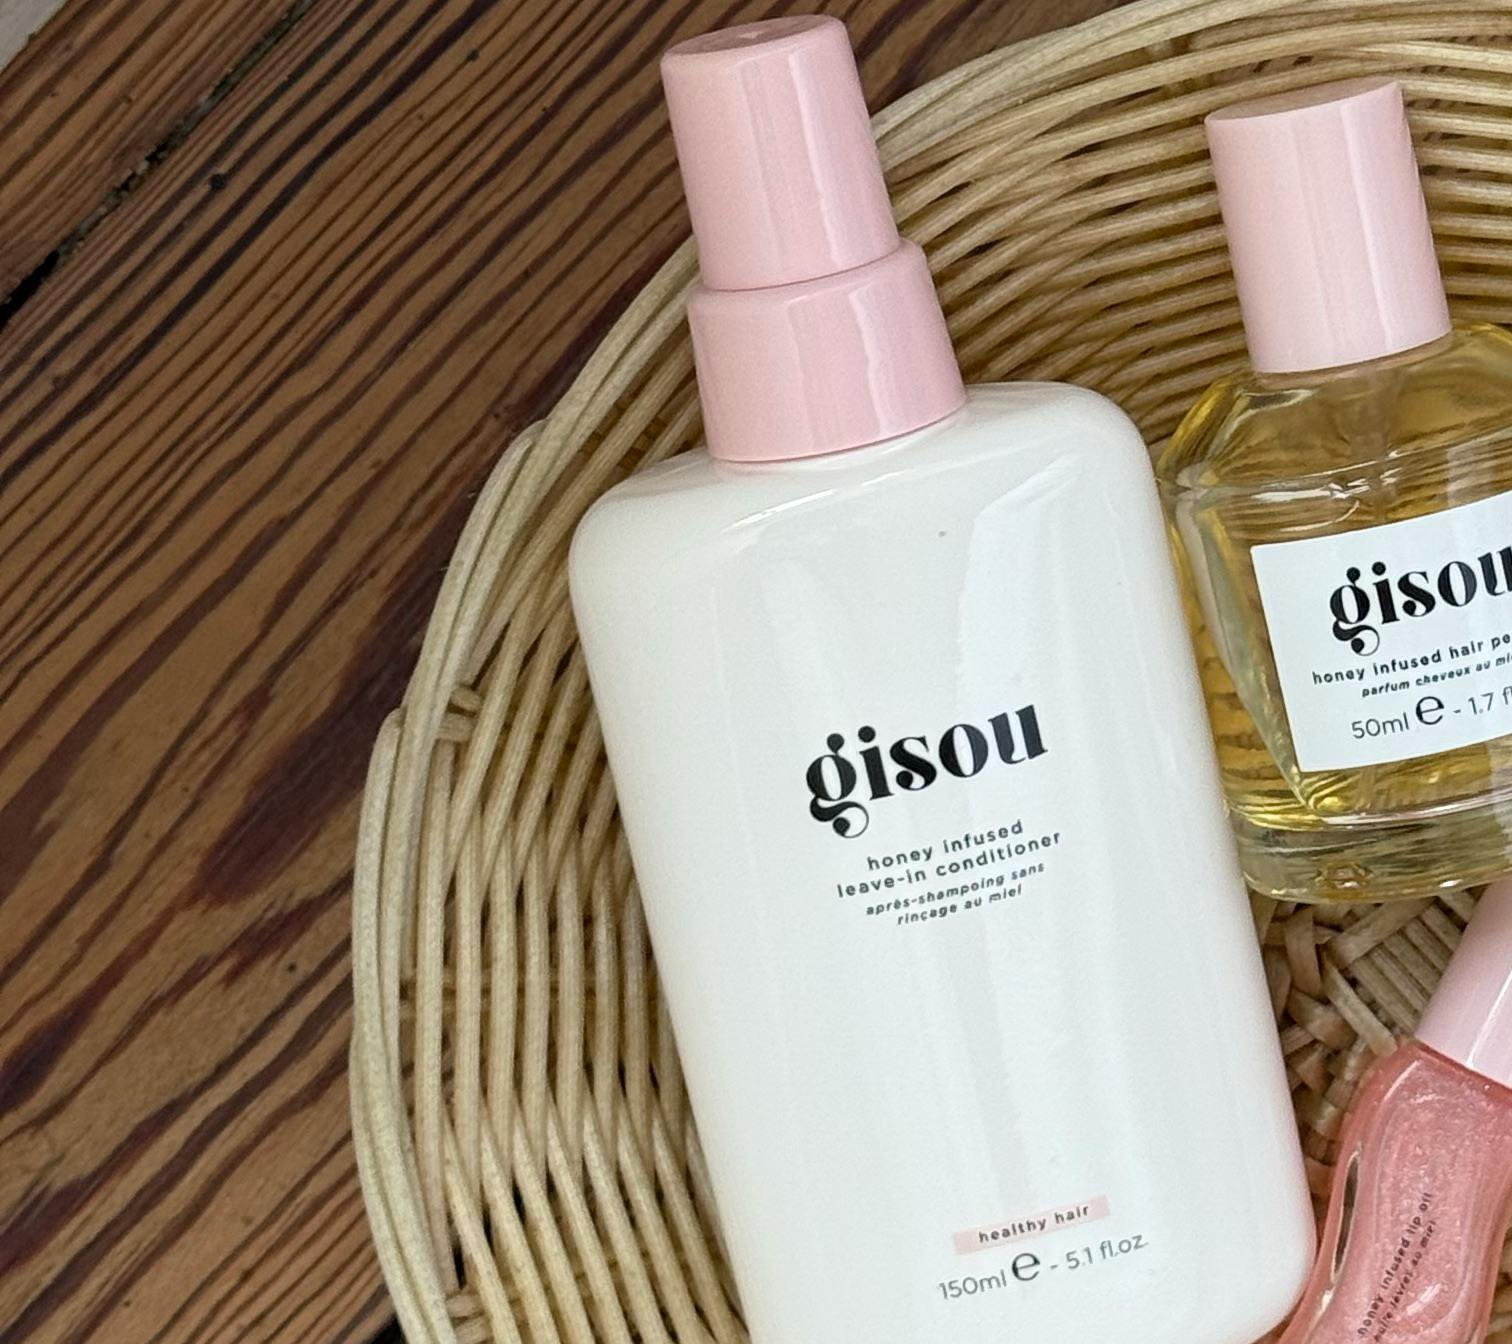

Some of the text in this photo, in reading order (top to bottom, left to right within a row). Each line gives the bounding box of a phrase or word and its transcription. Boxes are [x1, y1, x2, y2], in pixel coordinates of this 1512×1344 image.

[1312, 666, 1365, 686] honey
[1373, 650, 1442, 676] infused
[1449, 640, 1483, 660] hair
[1361, 678, 1410, 698] parfum
[1416, 667, 1471, 687] cheveux
[1476, 661, 1491, 673] au
[1351, 712, 1409, 739] 50ml
[1467, 693, 1494, 716] 1.7
[806, 704, 1048, 838] gisou
[837, 831, 1061, 898] leave-in conditioner
[867, 819, 1024, 871] honey infused
[866, 862, 1045, 916] après-shampoing sans
[897, 885, 1022, 925] rinçage au miel
[978, 1204, 1090, 1243] healthy hair
[938, 1269, 1007, 1299] 150ml
[1066, 1247, 1094, 1269] 5.1
[1357, 1192, 1432, 1335] honey infused lip oil
